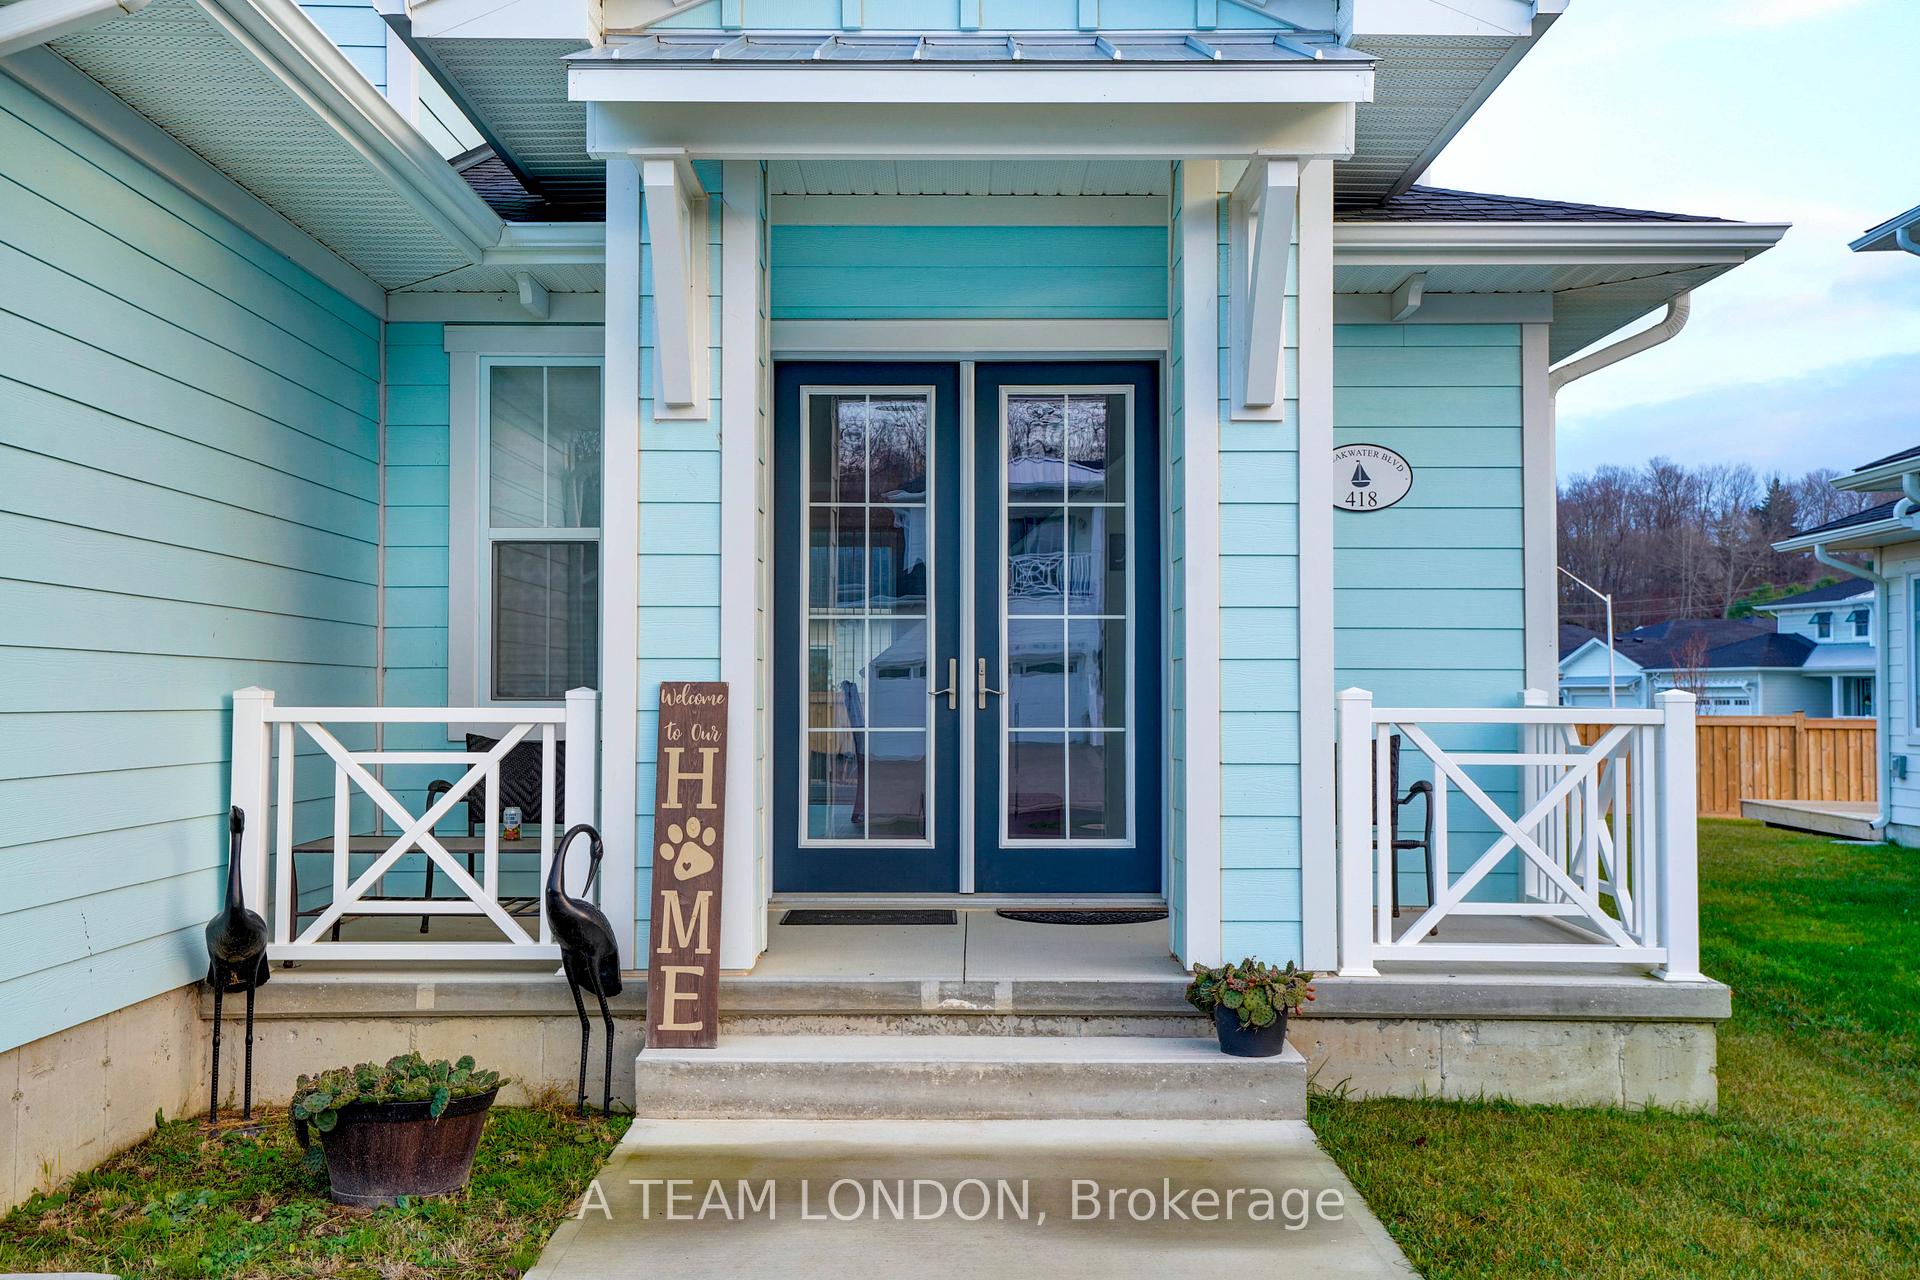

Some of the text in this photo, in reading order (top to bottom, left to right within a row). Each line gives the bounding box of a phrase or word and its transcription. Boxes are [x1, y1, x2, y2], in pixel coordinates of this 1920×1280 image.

[1333, 449, 1404, 472] AKWATER BLVD
[1345, 491, 1377, 507] 418
[661, 683, 725, 706] Welcome
[664, 721, 721, 742] to Our
[657, 747, 720, 1030] HME
